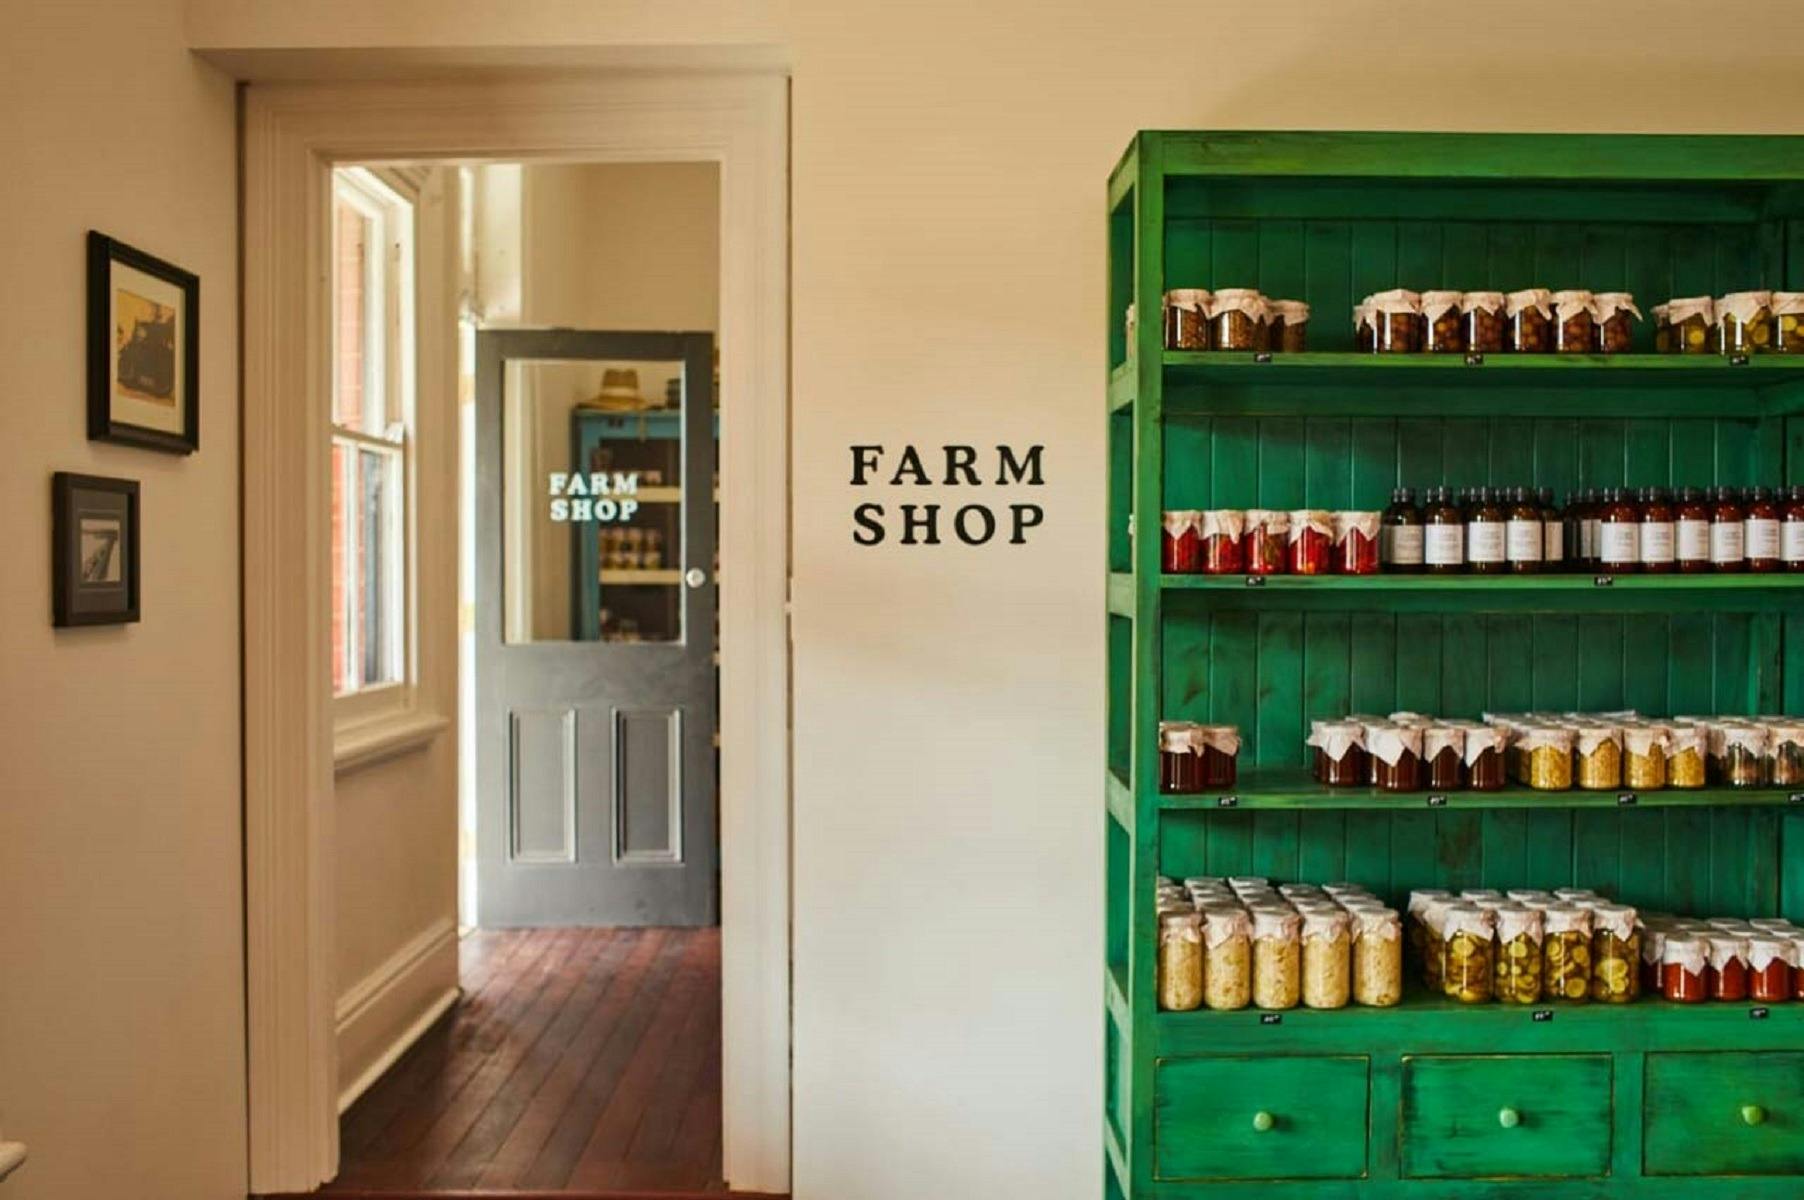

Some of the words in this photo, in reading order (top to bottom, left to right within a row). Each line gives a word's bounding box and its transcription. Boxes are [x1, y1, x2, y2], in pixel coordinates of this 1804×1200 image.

[849, 445, 1045, 486] FARM
[549, 472, 639, 496] FARM
[549, 498, 639, 522] SHOP
[853, 502, 1044, 547] SHOP
